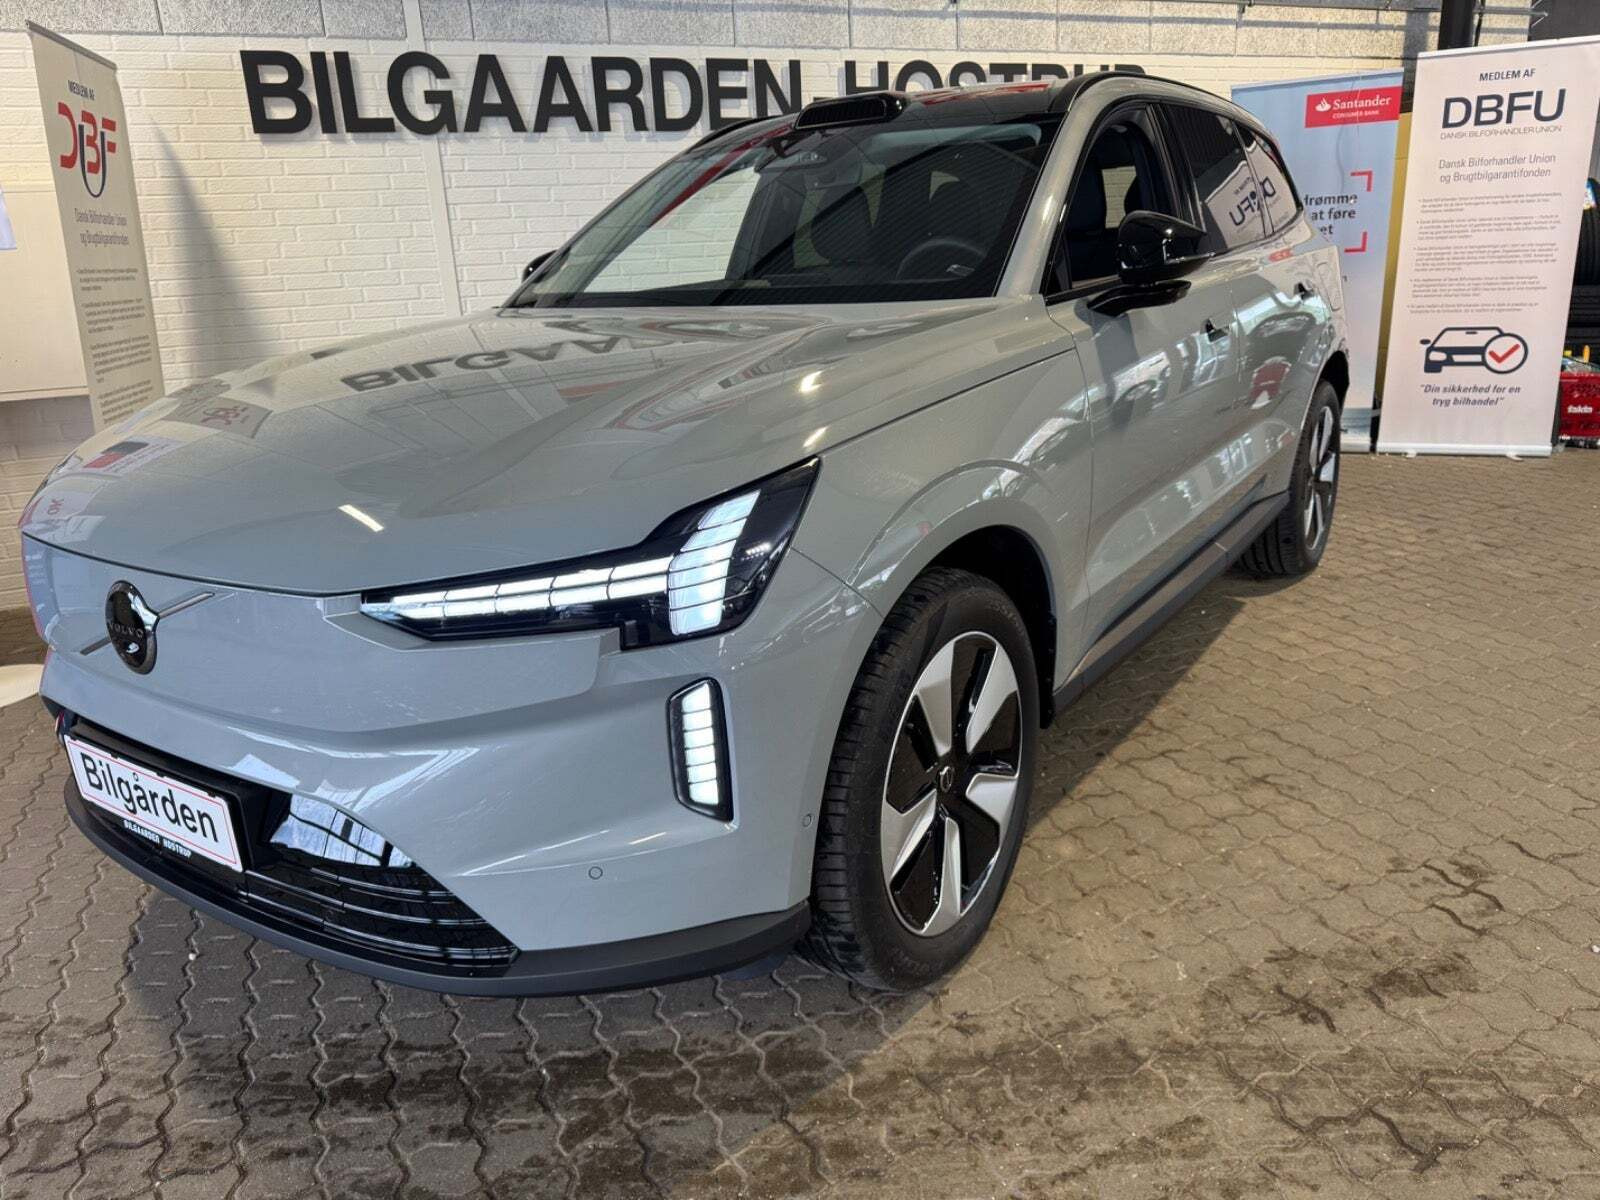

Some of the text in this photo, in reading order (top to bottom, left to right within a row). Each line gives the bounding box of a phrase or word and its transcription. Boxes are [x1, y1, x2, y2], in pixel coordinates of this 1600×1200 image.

[1479, 68, 1536, 82] MEDLEM AF
[240, 50, 800, 135] BILGAARDEN
[1333, 94, 1392, 110] Santander
[1442, 88, 1566, 129] DBFU
[1440, 125, 1562, 140] DANSK BILFORHANDLER UNION
[1438, 153, 1556, 169] Dansk Bilforhandler Union
[1440, 168, 1551, 184] og Brugtbilgarantifonden
[1328, 207, 1356, 220] føre
[1442, 384, 1491, 393] sikkerhed
[1493, 384, 1506, 393] for
[1432, 398, 1451, 407] tryg
[80, 752, 218, 843] Bilgården
